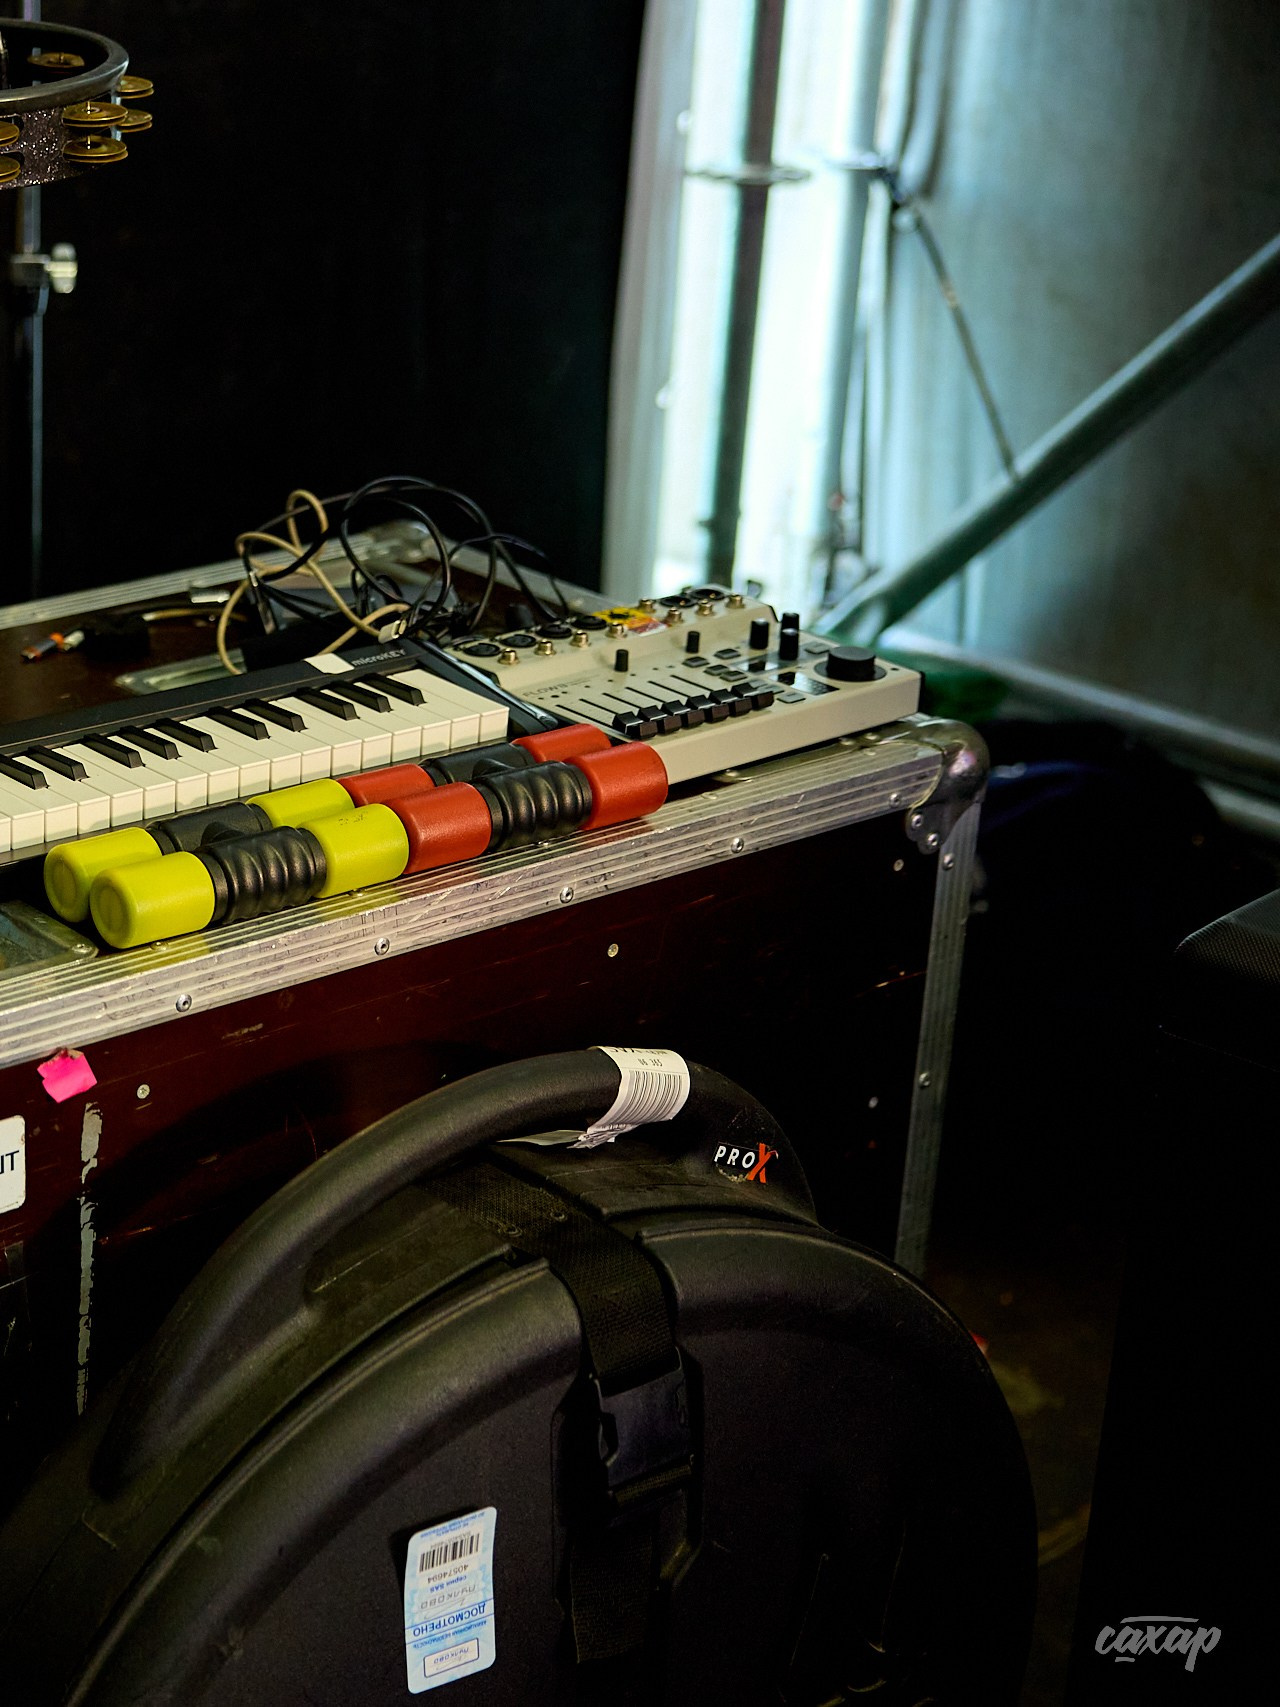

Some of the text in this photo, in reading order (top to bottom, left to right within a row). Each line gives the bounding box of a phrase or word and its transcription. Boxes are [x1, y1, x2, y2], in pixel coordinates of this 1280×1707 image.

[351, 648, 407, 667] microKEY
[427, 1563, 469, 1585] 40574694
[412, 1601, 487, 1638] ДОСМОТРЕНО
